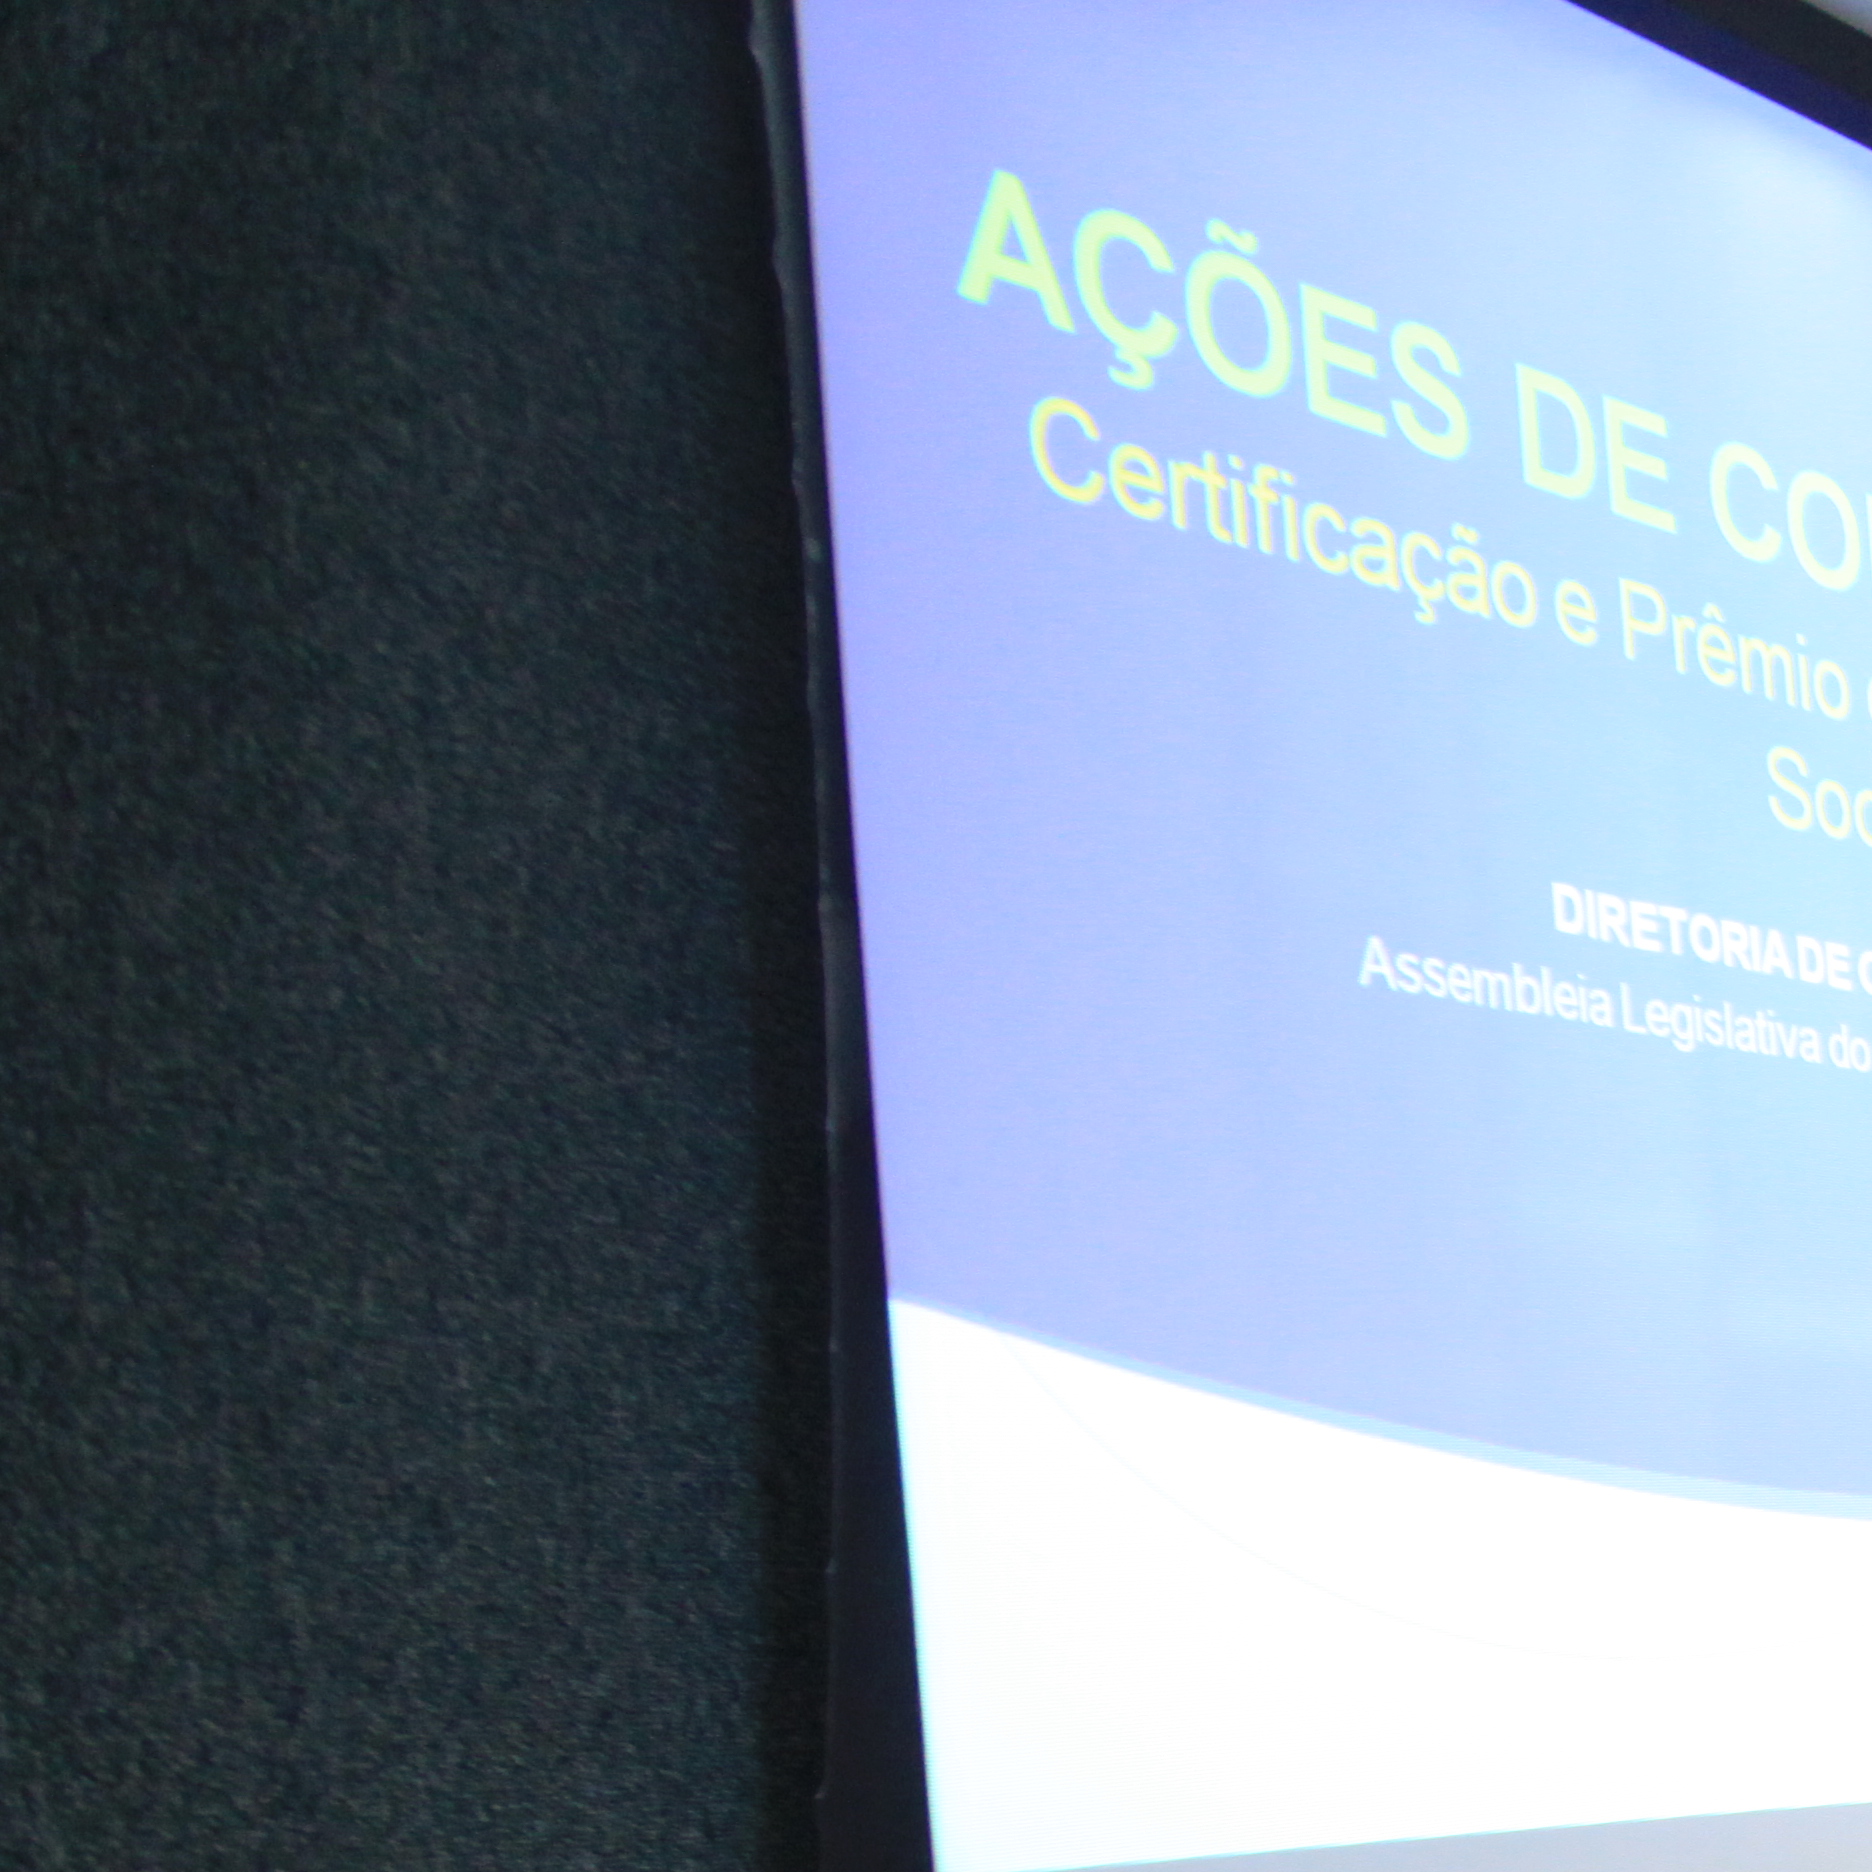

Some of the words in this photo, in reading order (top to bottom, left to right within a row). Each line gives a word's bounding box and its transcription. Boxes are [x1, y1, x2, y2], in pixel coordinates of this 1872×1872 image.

[956, 168, 1471, 460] AÇÕES
[1515, 362, 1678, 534] DE
[1029, 395, 1539, 624] Certificação
[1554, 580, 1599, 646] e
[1619, 578, 1852, 721] Prêmio
[1358, 934, 1615, 1029] Assembleia
[1621, 979, 1820, 1065] Legislativa
[1551, 881, 1794, 979] DIRETORIA
[1796, 934, 1851, 989] DE
